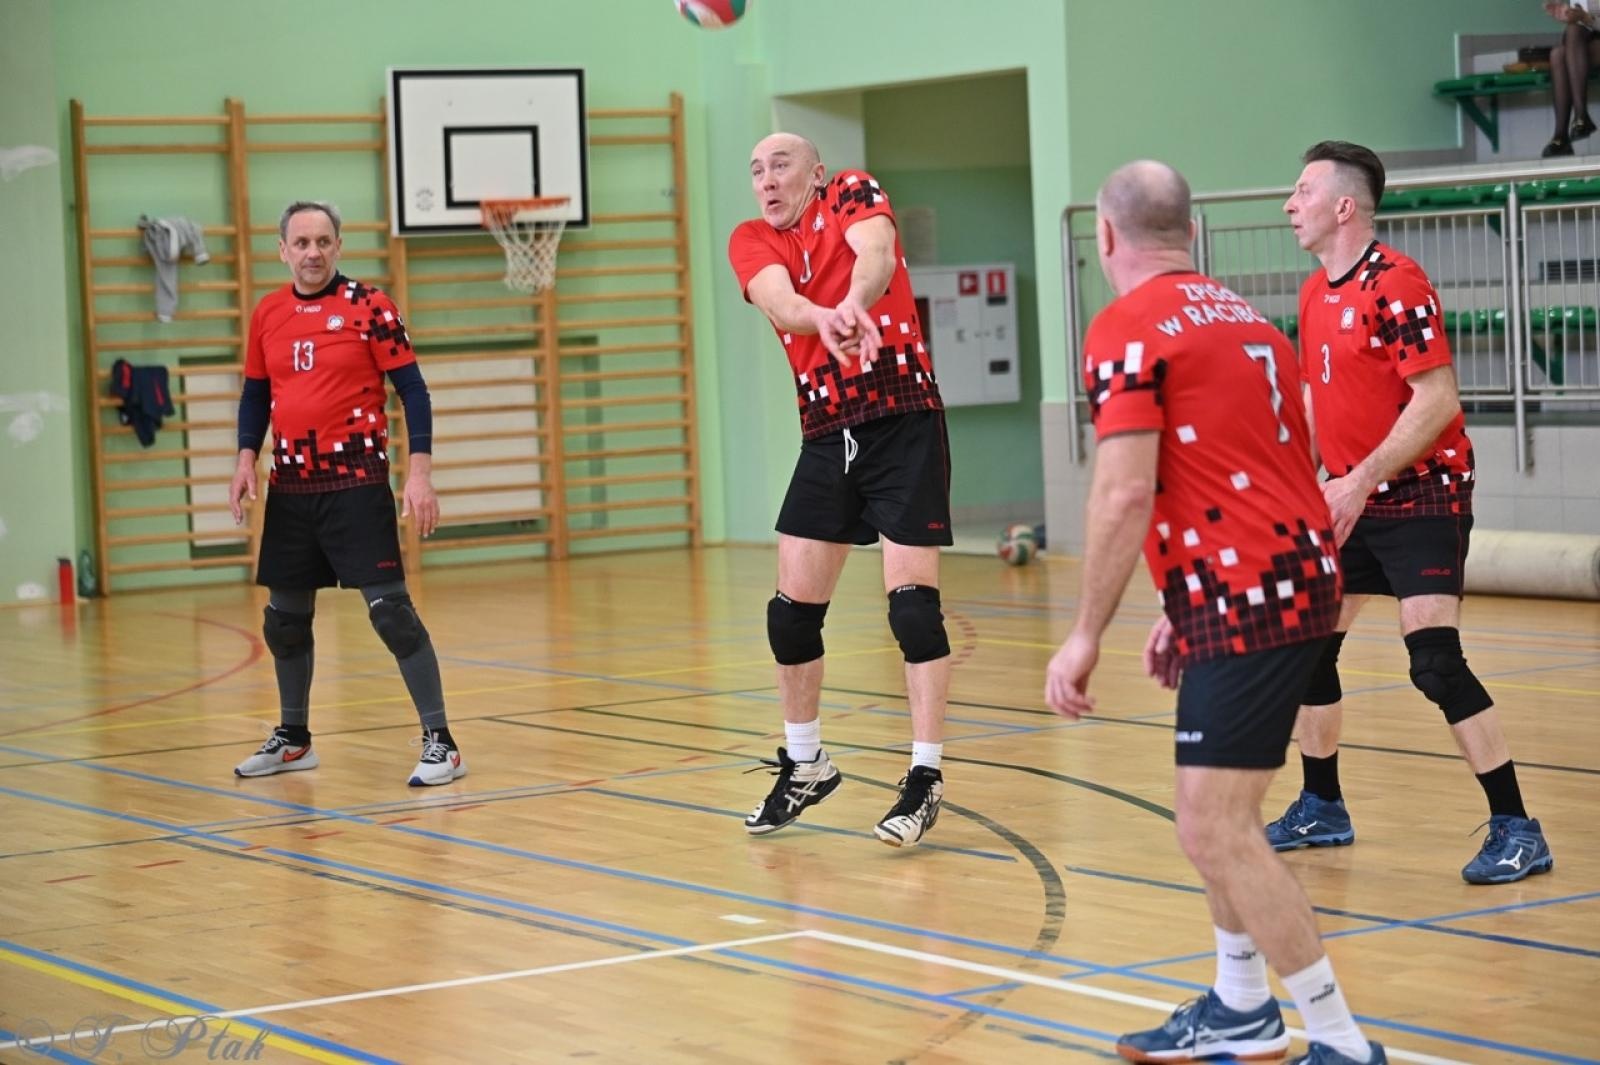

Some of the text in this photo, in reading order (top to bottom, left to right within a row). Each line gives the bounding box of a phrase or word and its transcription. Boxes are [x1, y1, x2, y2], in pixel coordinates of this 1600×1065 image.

[293, 340, 315, 372] 13
[1320, 343, 1331, 385] 3
[1241, 343, 1291, 443] 7
